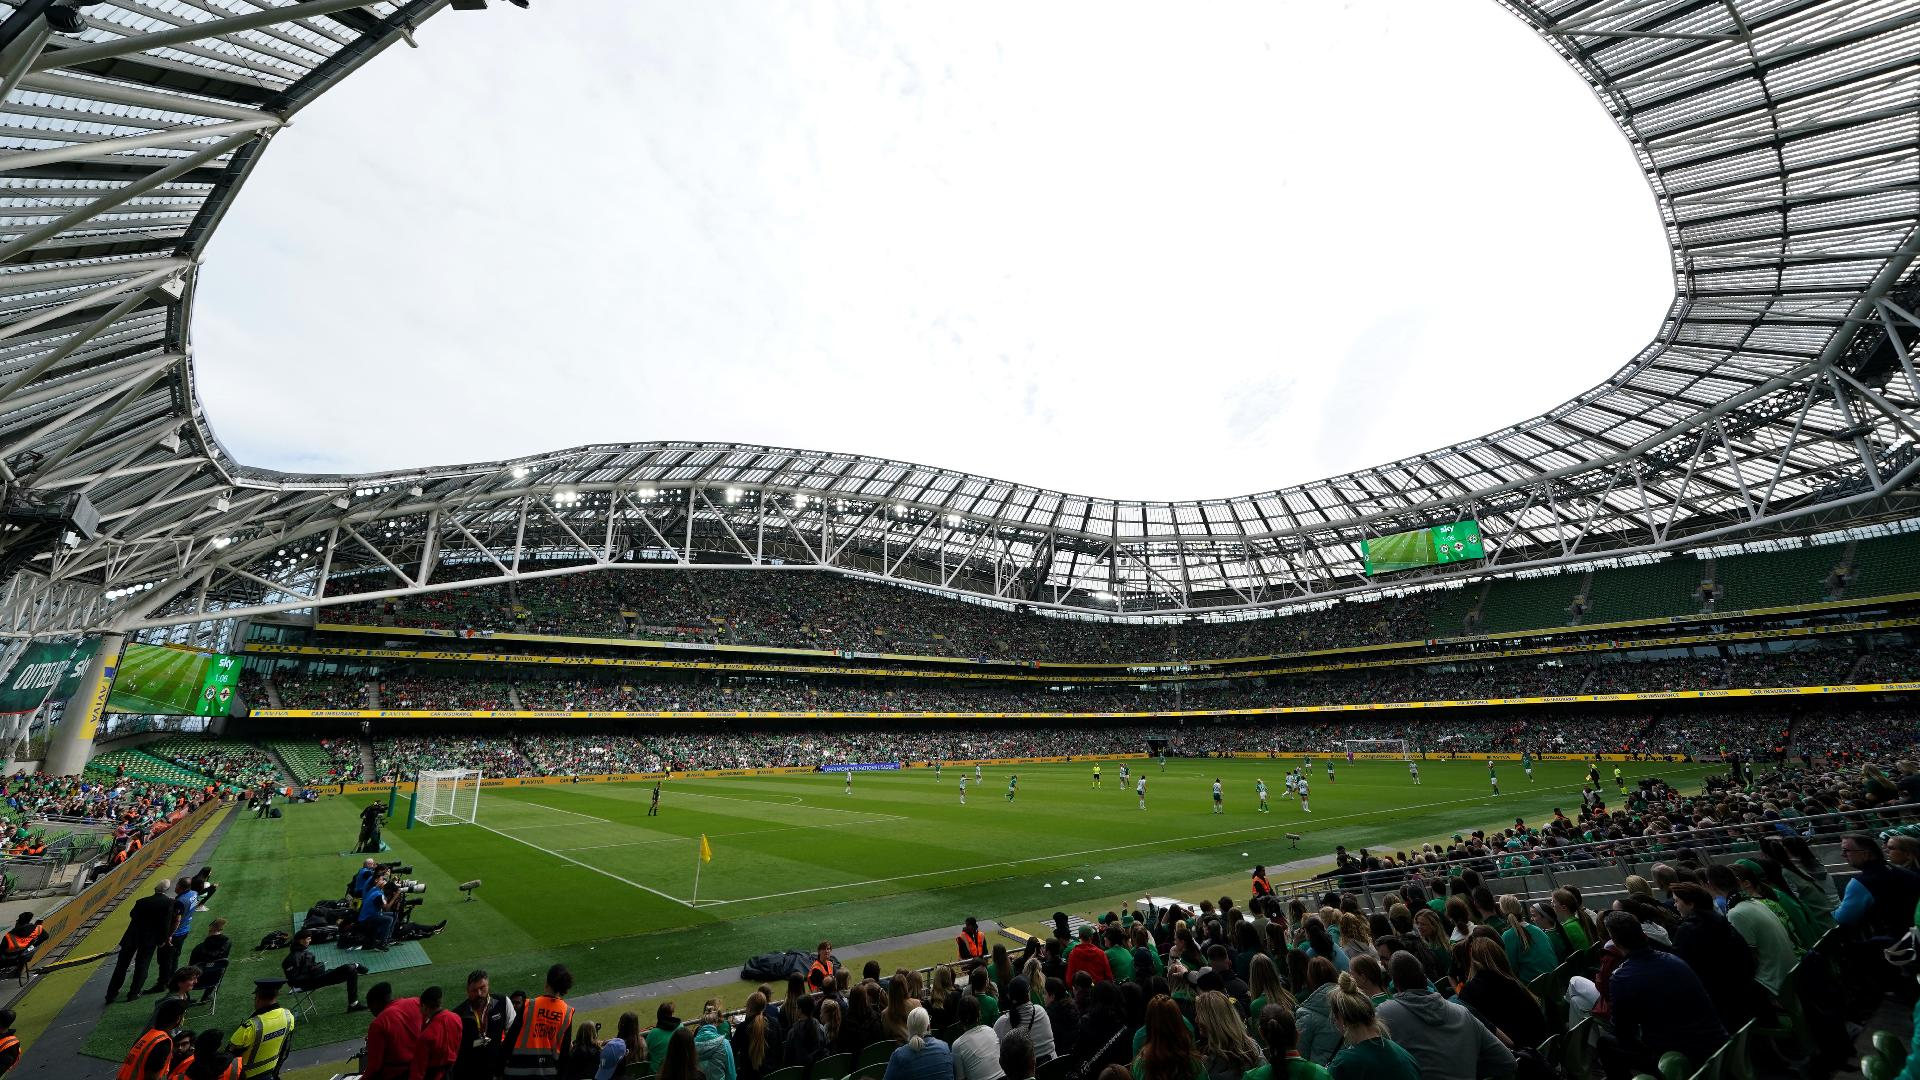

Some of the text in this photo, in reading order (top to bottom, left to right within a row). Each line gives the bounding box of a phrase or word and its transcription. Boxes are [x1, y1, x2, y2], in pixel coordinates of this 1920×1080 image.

[1441, 526, 1455, 534] sky
[219, 657, 235, 671] sky
[90, 685, 108, 723] AVIVA
